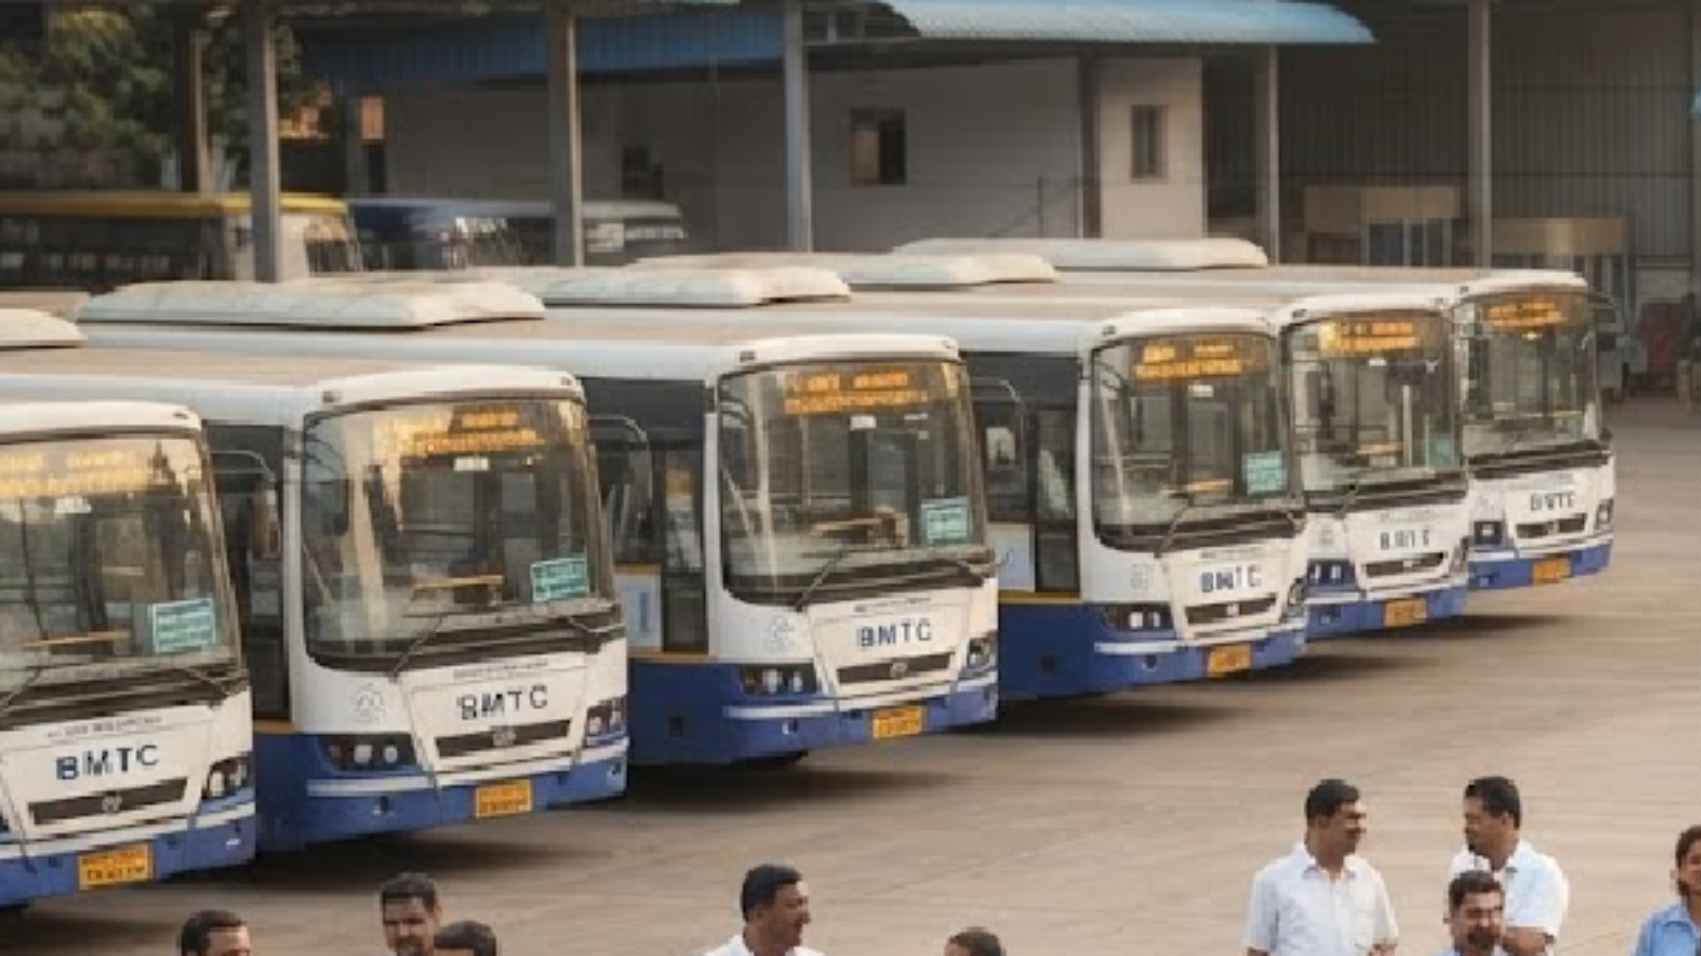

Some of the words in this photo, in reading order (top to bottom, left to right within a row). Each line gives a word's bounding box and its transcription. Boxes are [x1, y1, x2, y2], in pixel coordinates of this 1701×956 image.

[856, 617, 932, 648] BMTC
[457, 684, 549, 721] BMTC
[55, 744, 160, 781] BMTC
